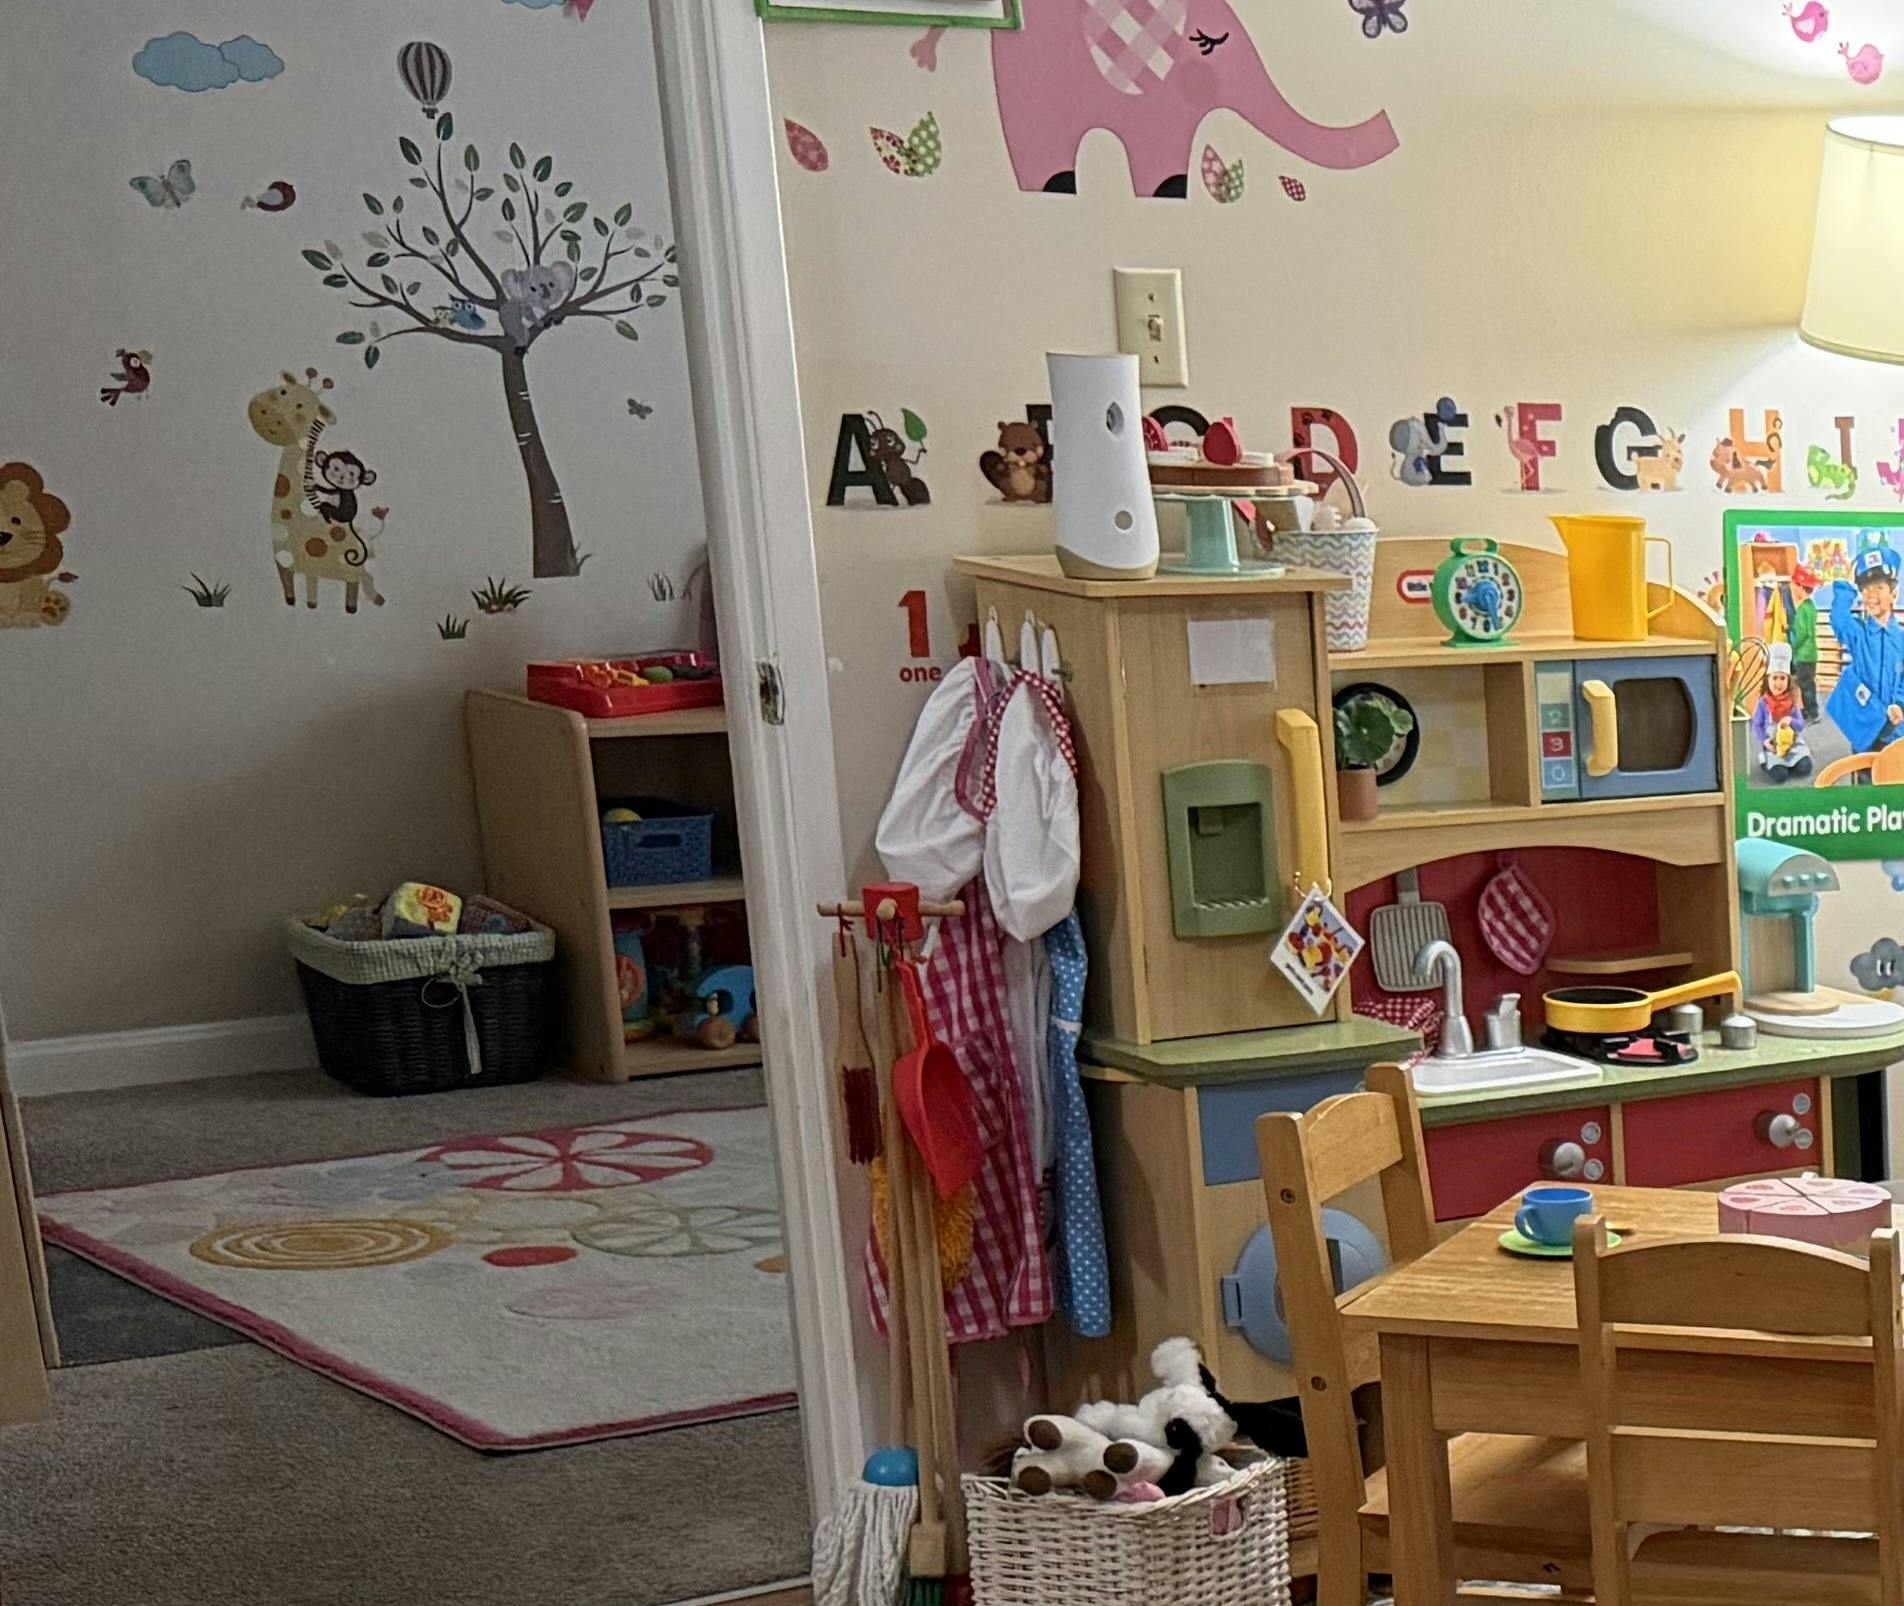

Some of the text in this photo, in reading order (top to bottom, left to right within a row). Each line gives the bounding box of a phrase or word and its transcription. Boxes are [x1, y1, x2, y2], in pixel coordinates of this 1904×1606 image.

[827, 413, 899, 506] A
[1517, 402, 1562, 491] F
[898, 590, 931, 658] 1
[900, 666, 942, 682] one
[1747, 807, 1860, 838] Dramatic
